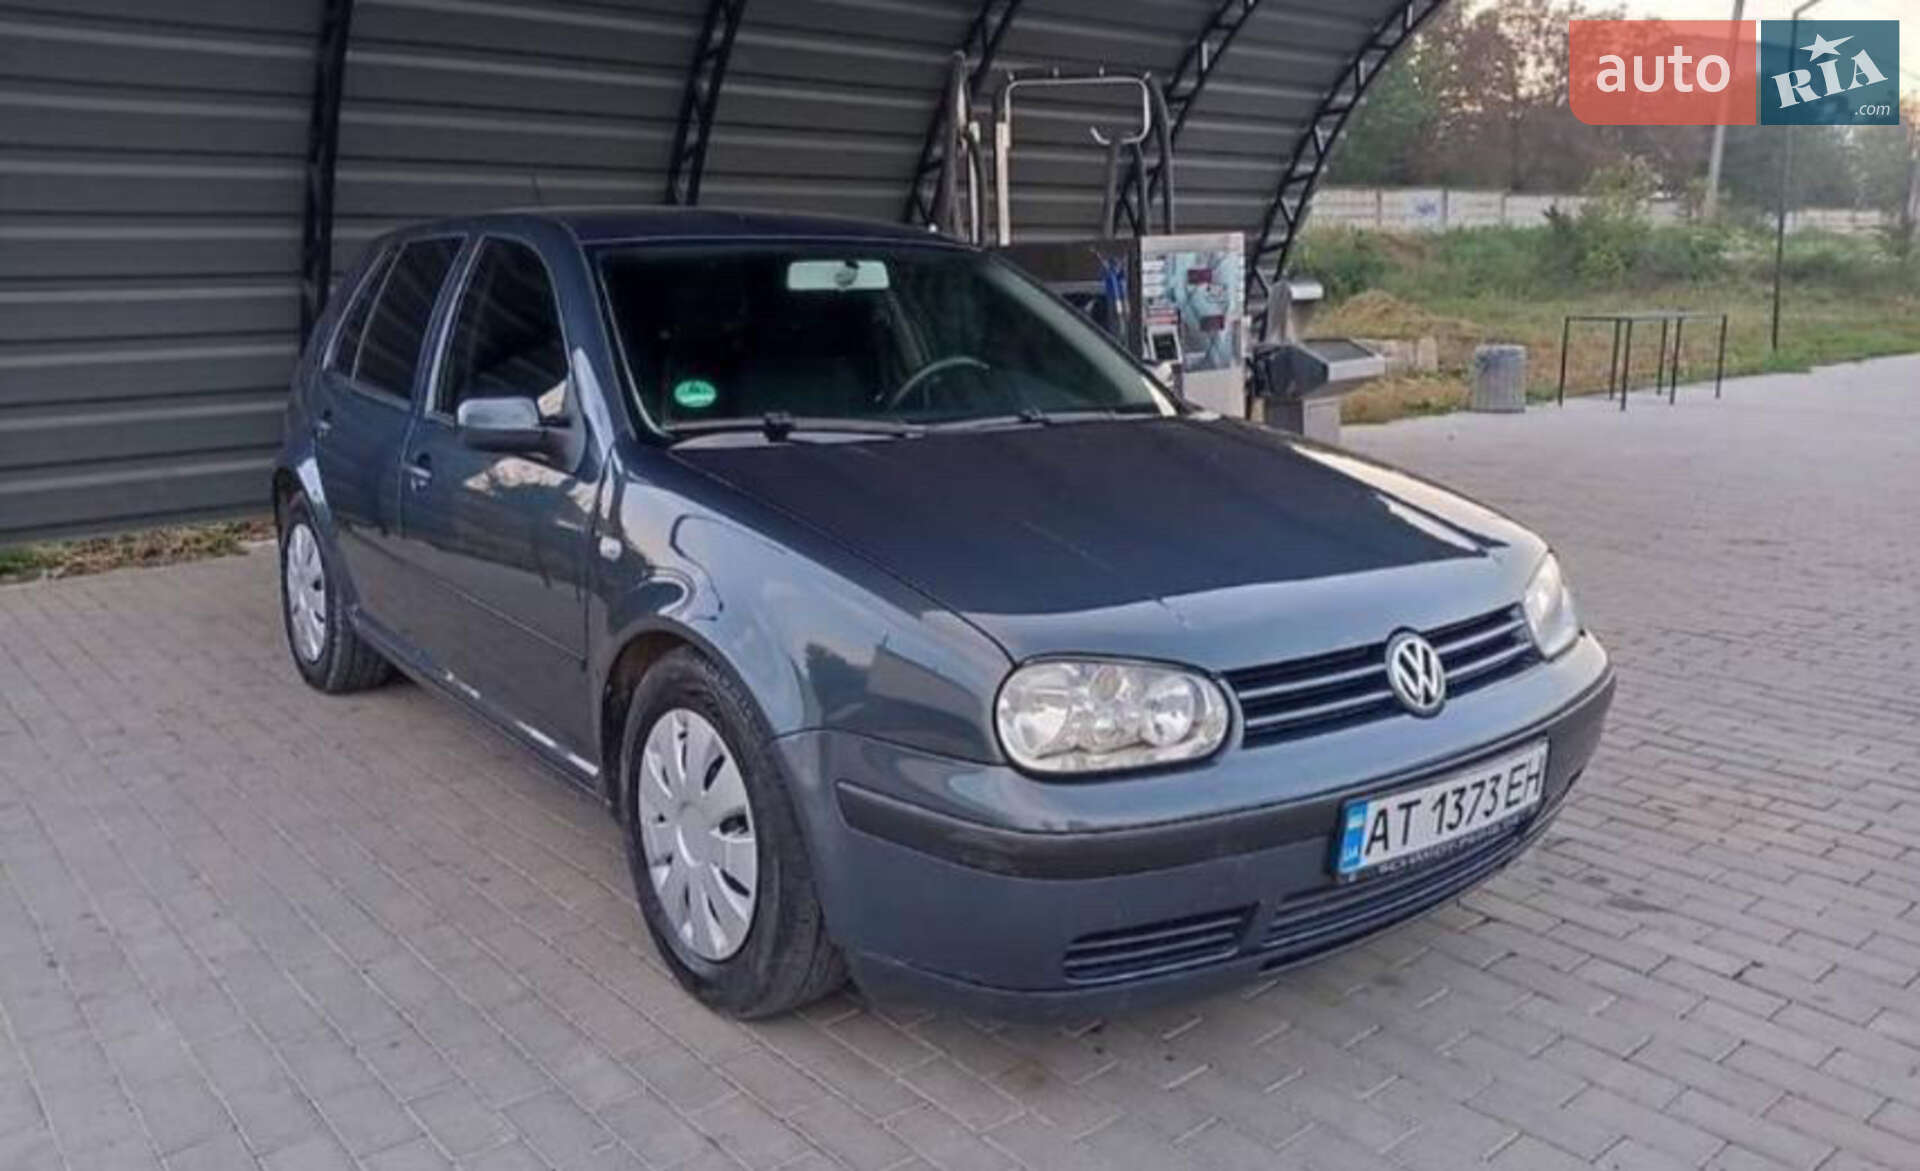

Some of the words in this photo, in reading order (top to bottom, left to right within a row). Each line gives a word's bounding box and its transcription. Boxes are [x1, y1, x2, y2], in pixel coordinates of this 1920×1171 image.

[1365, 799, 1421, 856] AT
[1431, 773, 1502, 835] 1373
[1504, 758, 1543, 807] EH
